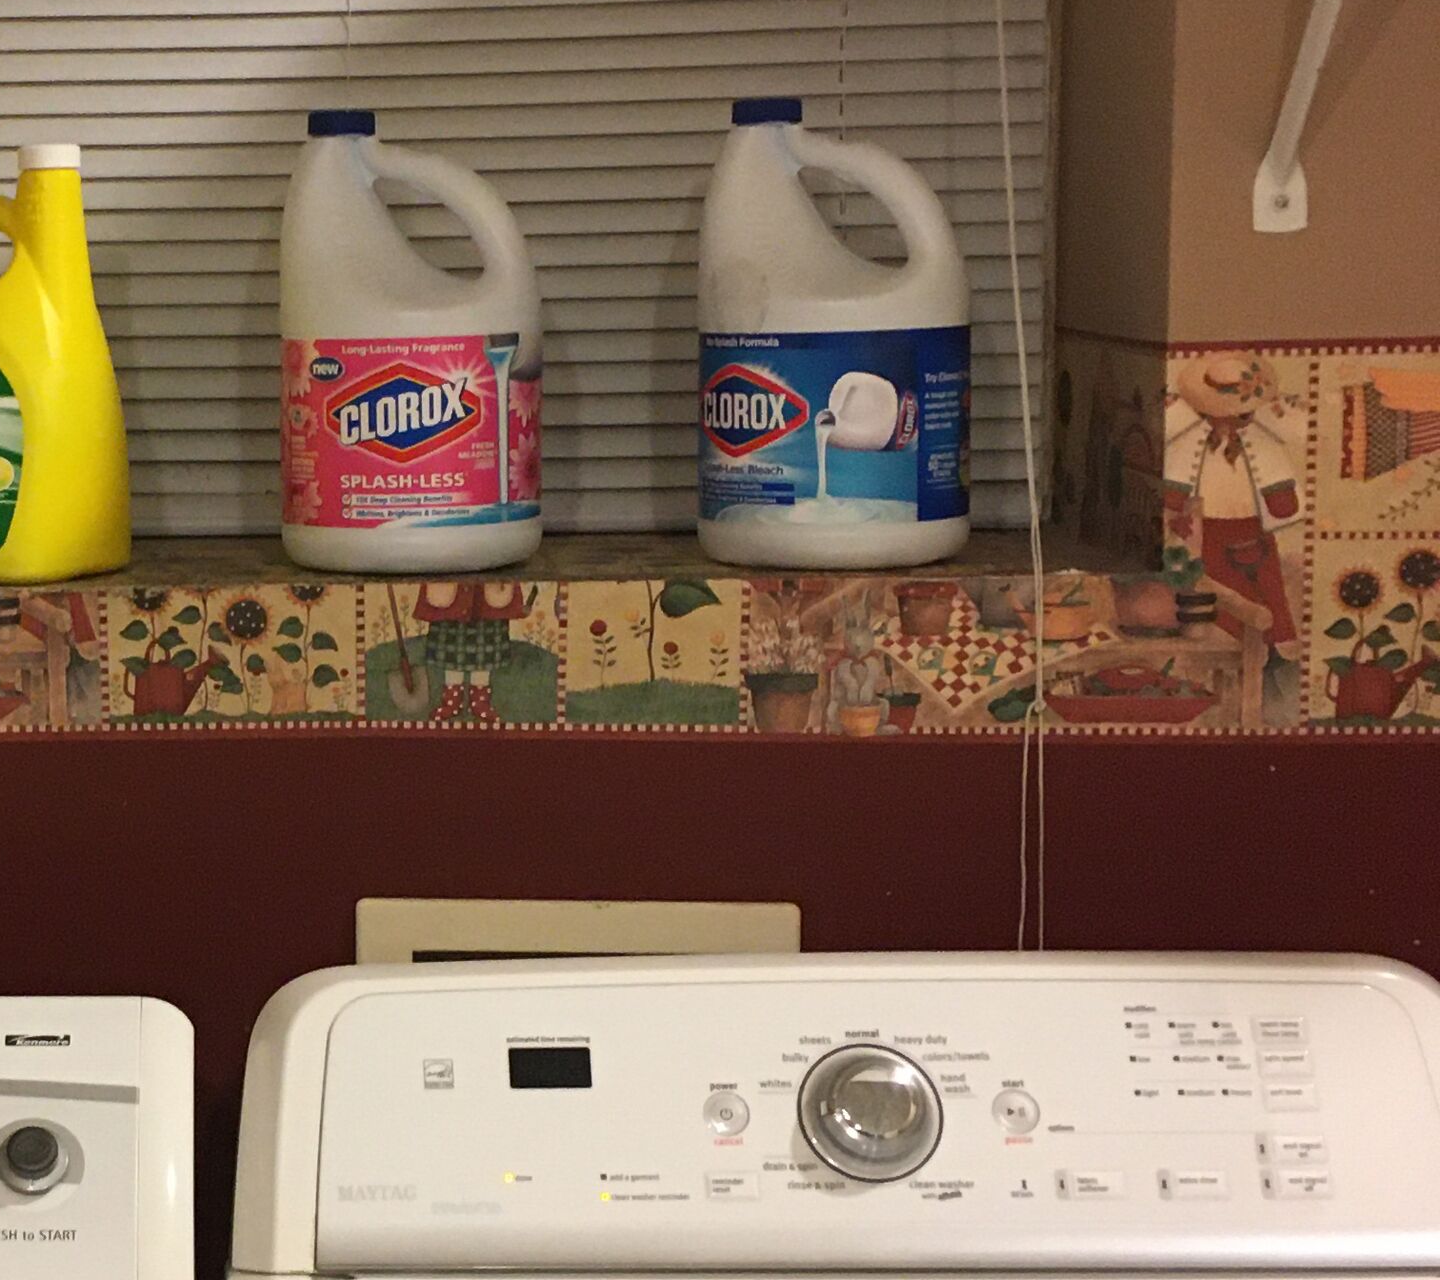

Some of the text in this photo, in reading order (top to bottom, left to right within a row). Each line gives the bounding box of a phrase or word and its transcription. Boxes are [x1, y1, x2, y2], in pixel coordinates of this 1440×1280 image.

[740, 337, 780, 348] Formula
[341, 342, 465, 357] Long-Lasting Fragrance
[312, 363, 339, 376] new
[338, 376, 467, 447] CLOROX
[703, 392, 787, 431] CLOROX
[747, 463, 785, 475] Bleach
[340, 472, 466, 489] SPLASH-LESS
[389, 494, 422, 504] Cleaning
[423, 493, 453, 503] Benefits
[844, 1029, 881, 1039] normal
[799, 1036, 832, 1046] sheets
[894, 1034, 948, 1046] heavy duty
[782, 1053, 810, 1064] bulky
[922, 1051, 990, 1062] colors/towels
[940, 1073, 966, 1082] hand
[710, 1082, 738, 1092] power
[759, 1079, 793, 1089] whites
[944, 1084, 971, 1094] wash
[1001, 1079, 1025, 1088] start
[713, 1137, 744, 1147] cancel
[763, 1161, 788, 1171] drain
[787, 1180, 812, 1190] rinse
[824, 1180, 846, 1192] spin
[910, 1180, 975, 1190] clean washer
[338, 1185, 417, 1202] MAYTAG
[22, 1231, 35, 1241] to
[39, 1228, 77, 1241] START
